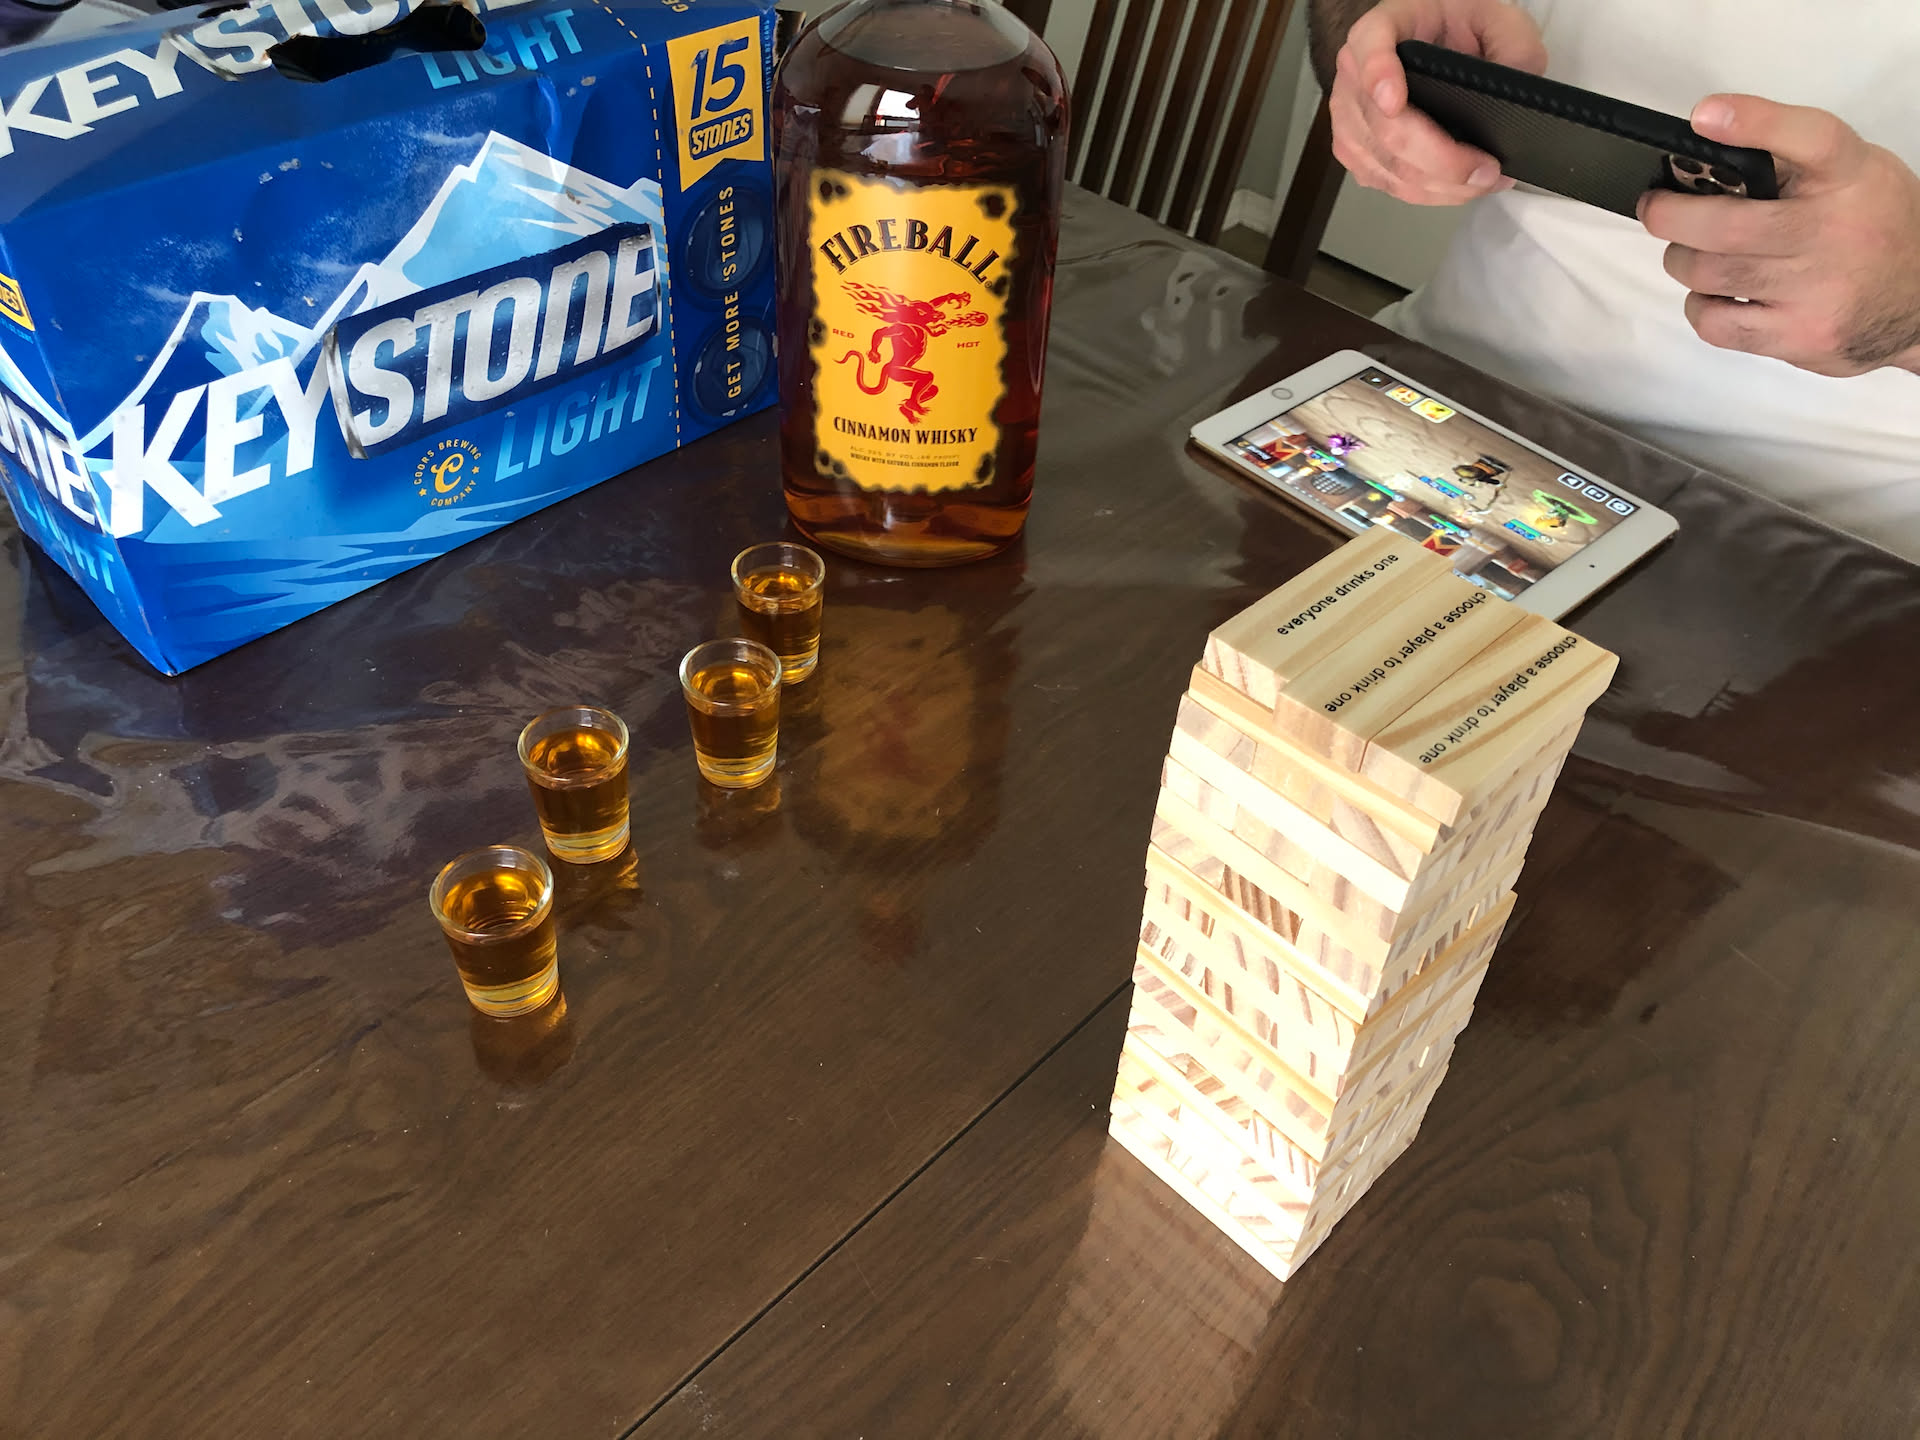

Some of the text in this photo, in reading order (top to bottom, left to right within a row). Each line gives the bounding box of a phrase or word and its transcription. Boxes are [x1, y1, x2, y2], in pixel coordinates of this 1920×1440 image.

[691, 37, 749, 120] 15
[724, 291, 740, 351] MORE
[832, 328, 981, 349] RED HOT
[101, 234, 657, 538] KEYSTONE
[727, 362, 742, 398] GET
[495, 356, 661, 481] LIGHT
[834, 416, 978, 445] CINNAMON WHISKY
[413, 438, 482, 485] COORS BREWING
[430, 479, 476, 507] COMPANY
[1277, 554, 1399, 635] everyone drinks one
[1324, 592, 1486, 712] choose a player to drink one
[1419, 636, 1578, 764] choose a player to drink one
